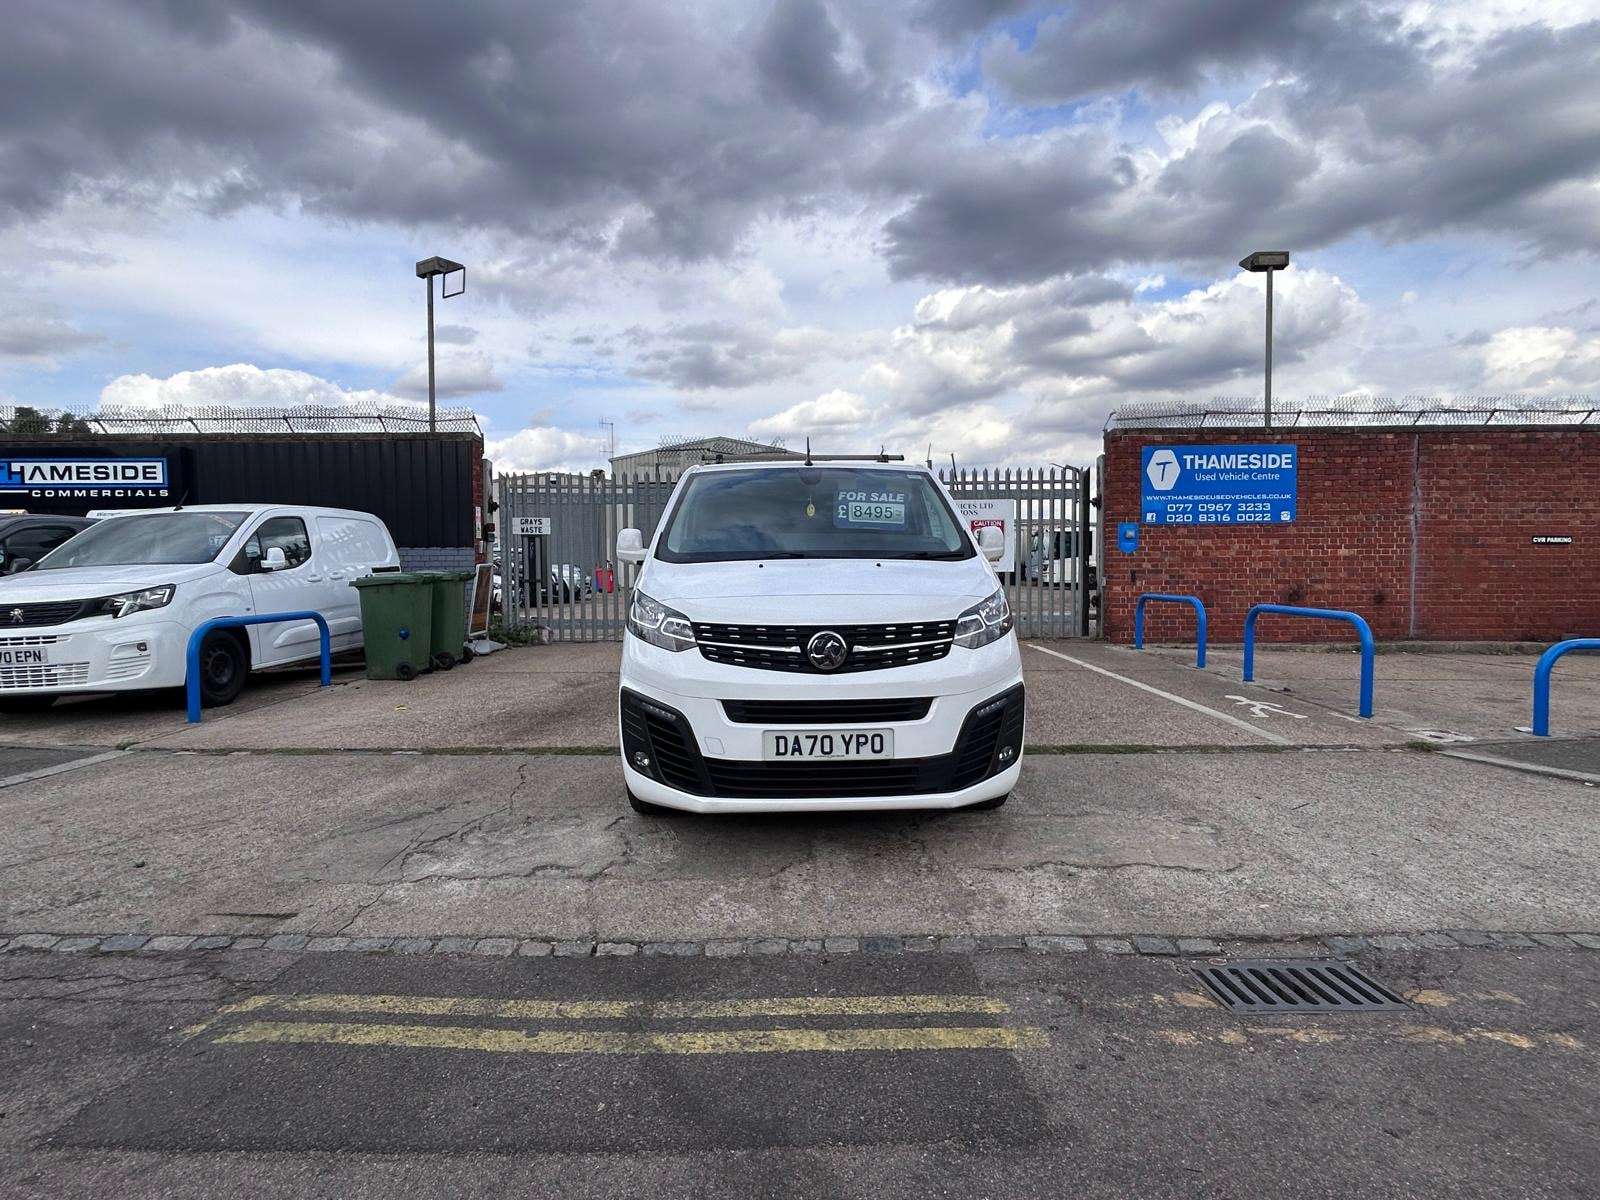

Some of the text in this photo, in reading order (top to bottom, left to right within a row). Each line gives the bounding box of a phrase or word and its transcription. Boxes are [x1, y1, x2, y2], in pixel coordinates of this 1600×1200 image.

[1183, 454, 1293, 470] THAMESIDE
[1195, 472, 1280, 481] Used Vehicle Centre
[32, 489, 169, 498] COMMERCIALS
[838, 491, 905, 502] FOR SALE
[853, 505, 893, 519] 8495
[1167, 503, 1271, 512] 077 0967 3233
[1166, 513, 1272, 522] 020 8316 0022
[520, 526, 544, 534] WASTE
[15, 650, 42, 662] EPN
[775, 733, 884, 756] DA70 YPO
